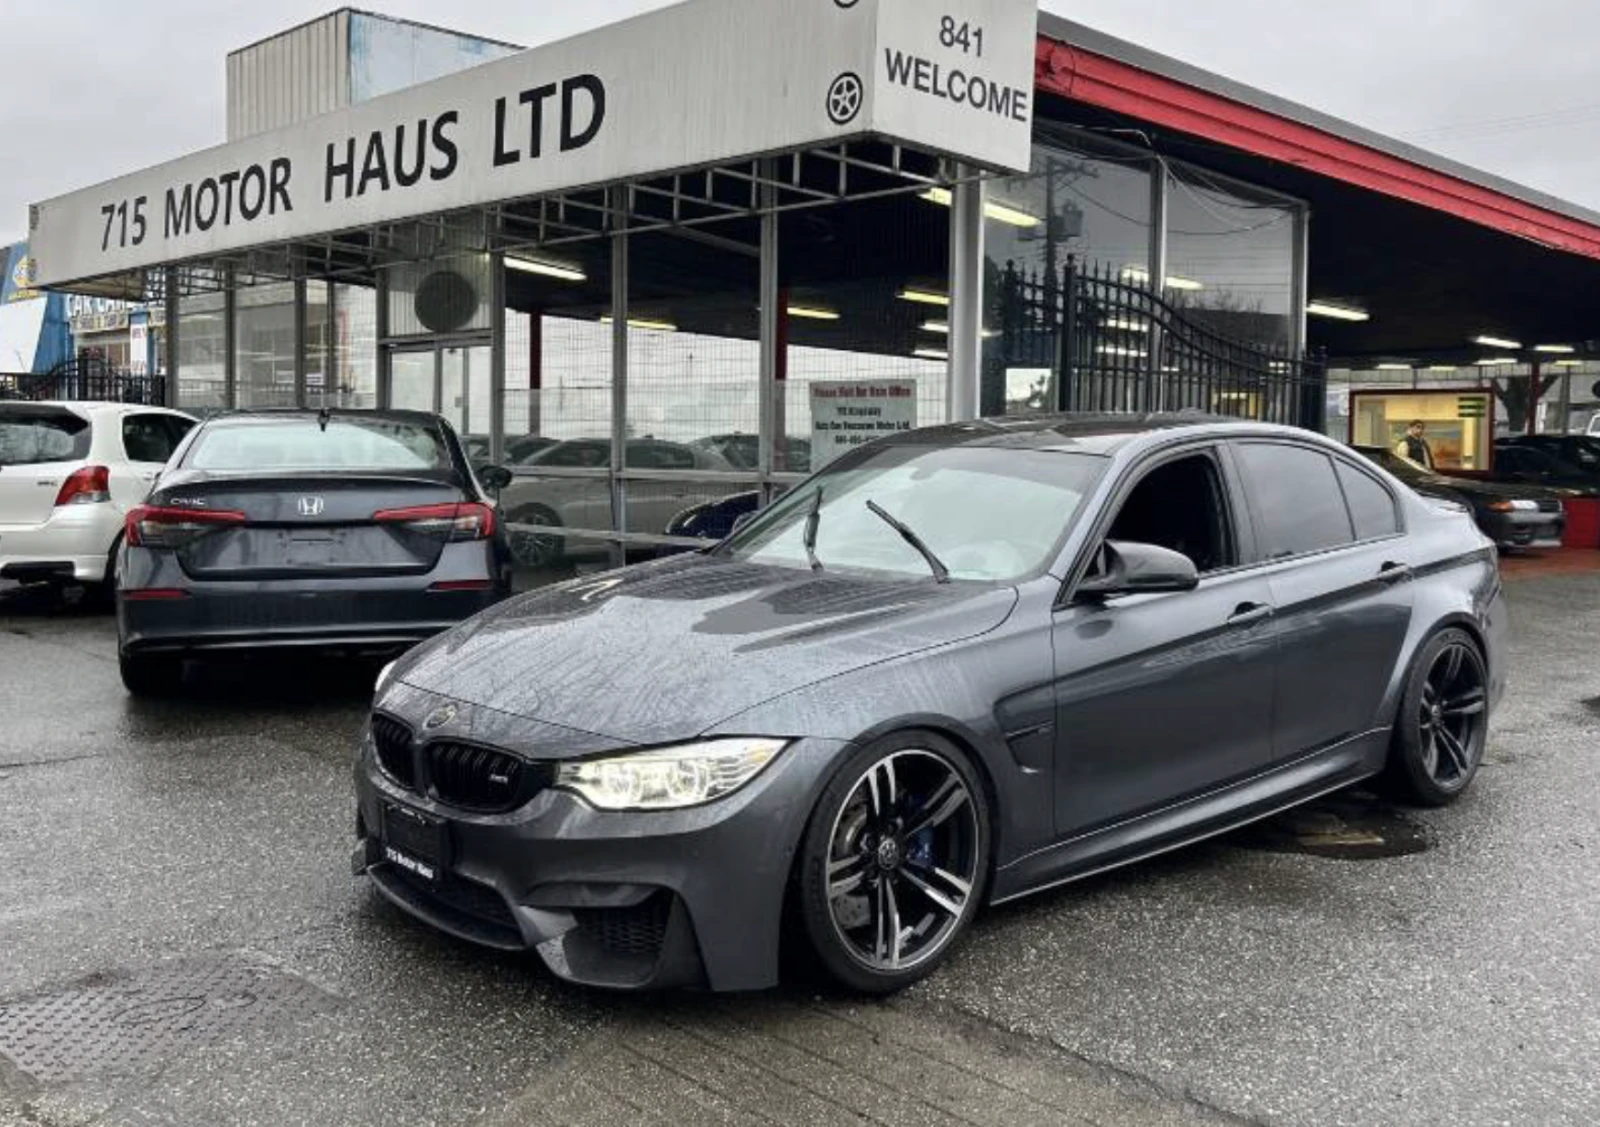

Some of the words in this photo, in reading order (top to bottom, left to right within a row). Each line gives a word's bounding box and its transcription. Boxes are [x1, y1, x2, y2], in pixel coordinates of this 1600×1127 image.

[939, 15, 983, 57] 841
[885, 48, 1027, 122] WELCOME
[101, 196, 147, 251] 715
[164, 157, 293, 239] MOTOR
[324, 110, 458, 203] HAUS
[493, 74, 606, 167] LTD
